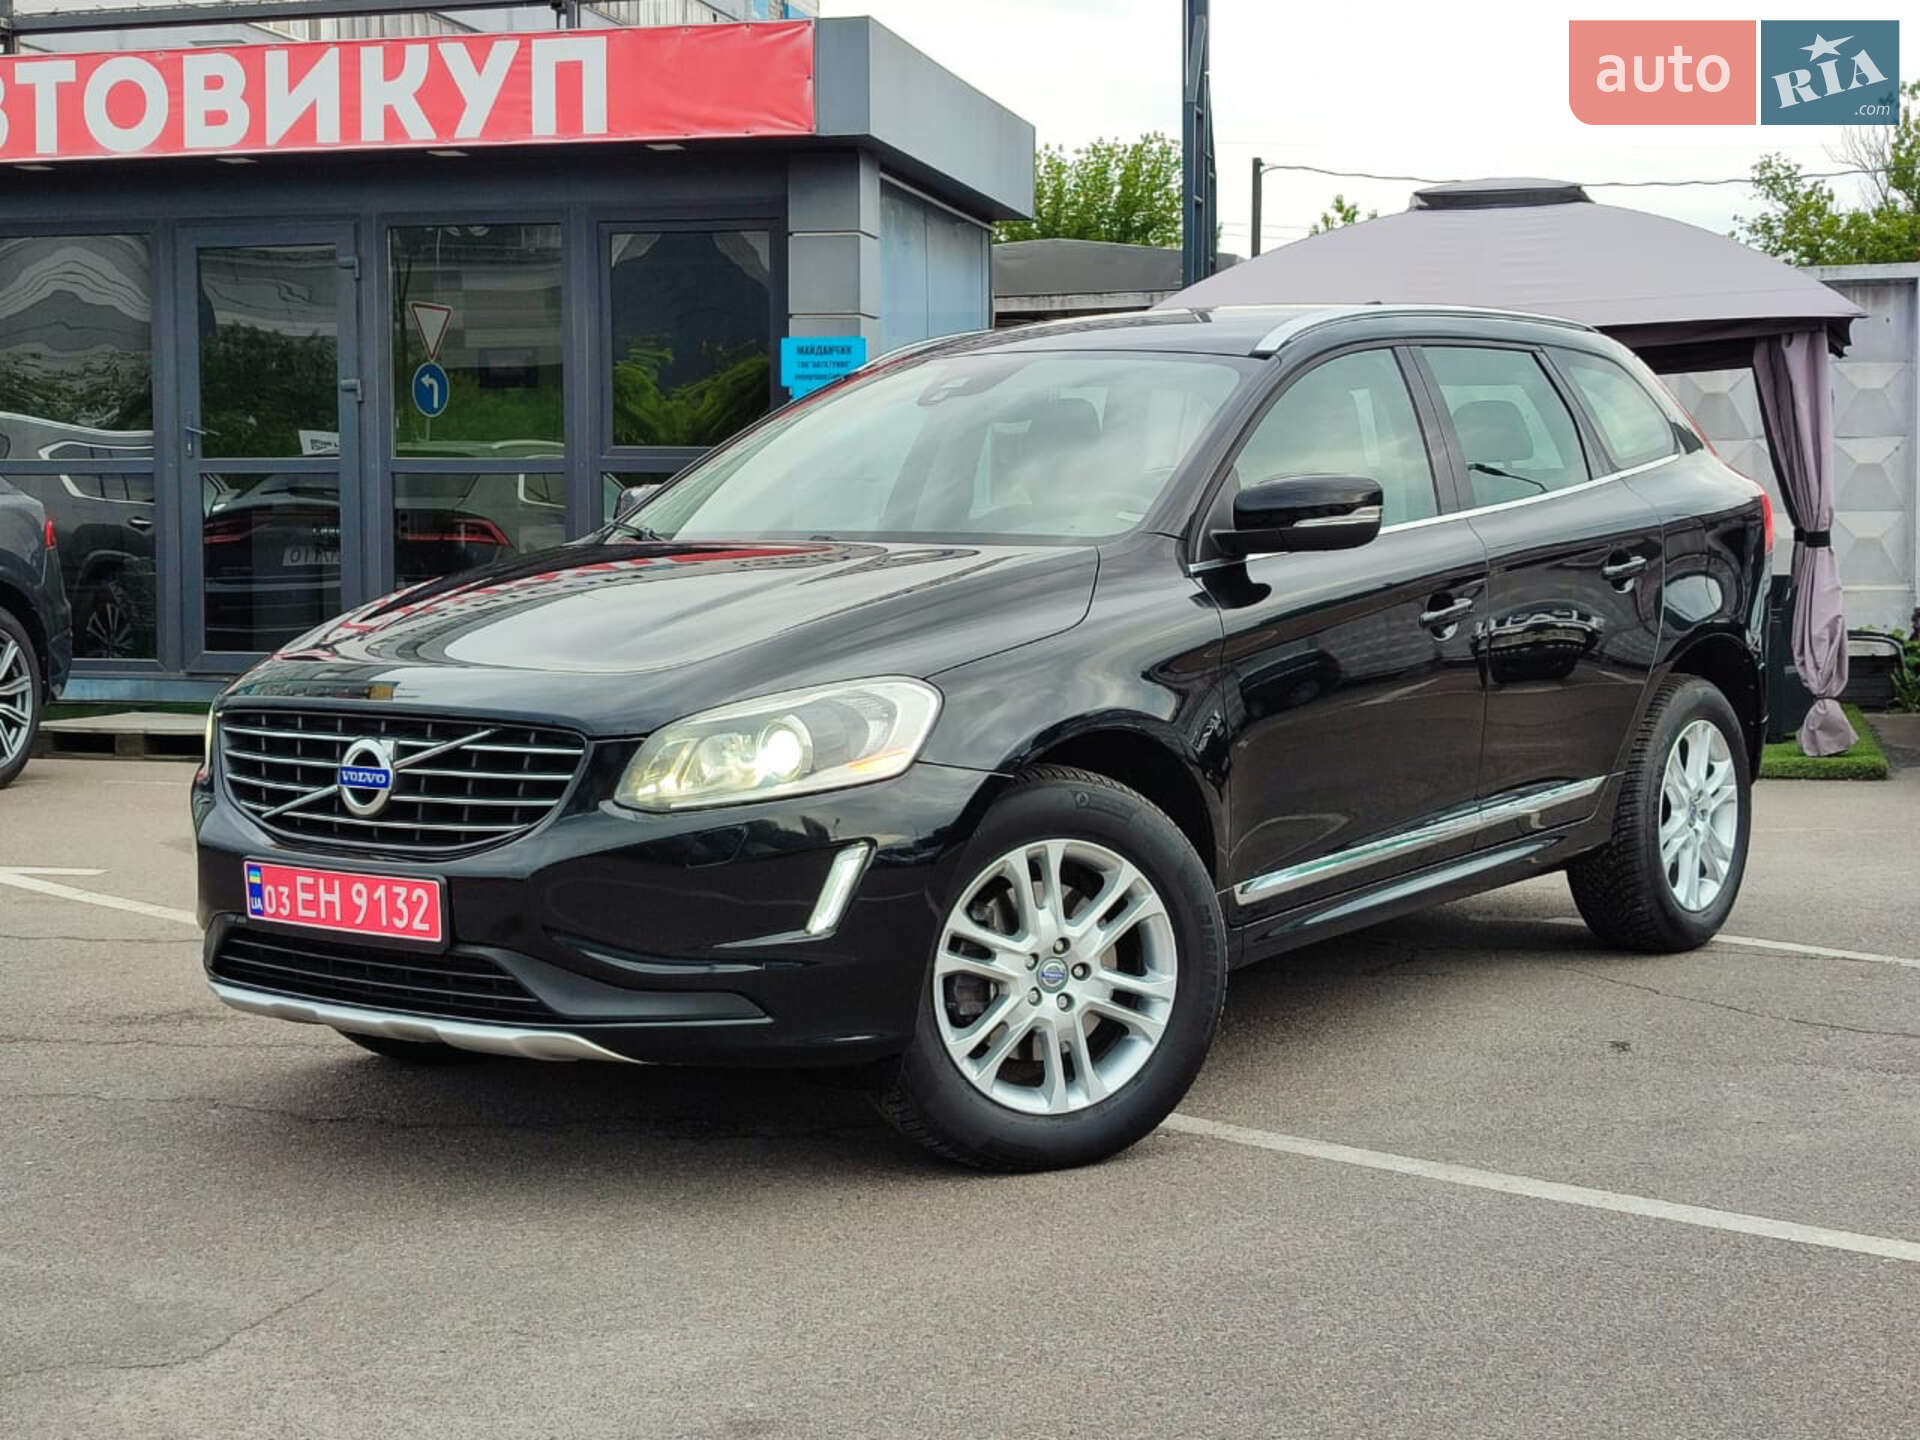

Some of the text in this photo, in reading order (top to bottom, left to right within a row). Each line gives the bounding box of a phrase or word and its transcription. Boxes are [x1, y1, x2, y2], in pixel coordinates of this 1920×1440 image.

[0, 36, 608, 154] ТОВИКУП
[341, 770, 387, 784] VOLVO
[251, 896, 263, 911] UA
[264, 875, 430, 931] 03 EH 9132
